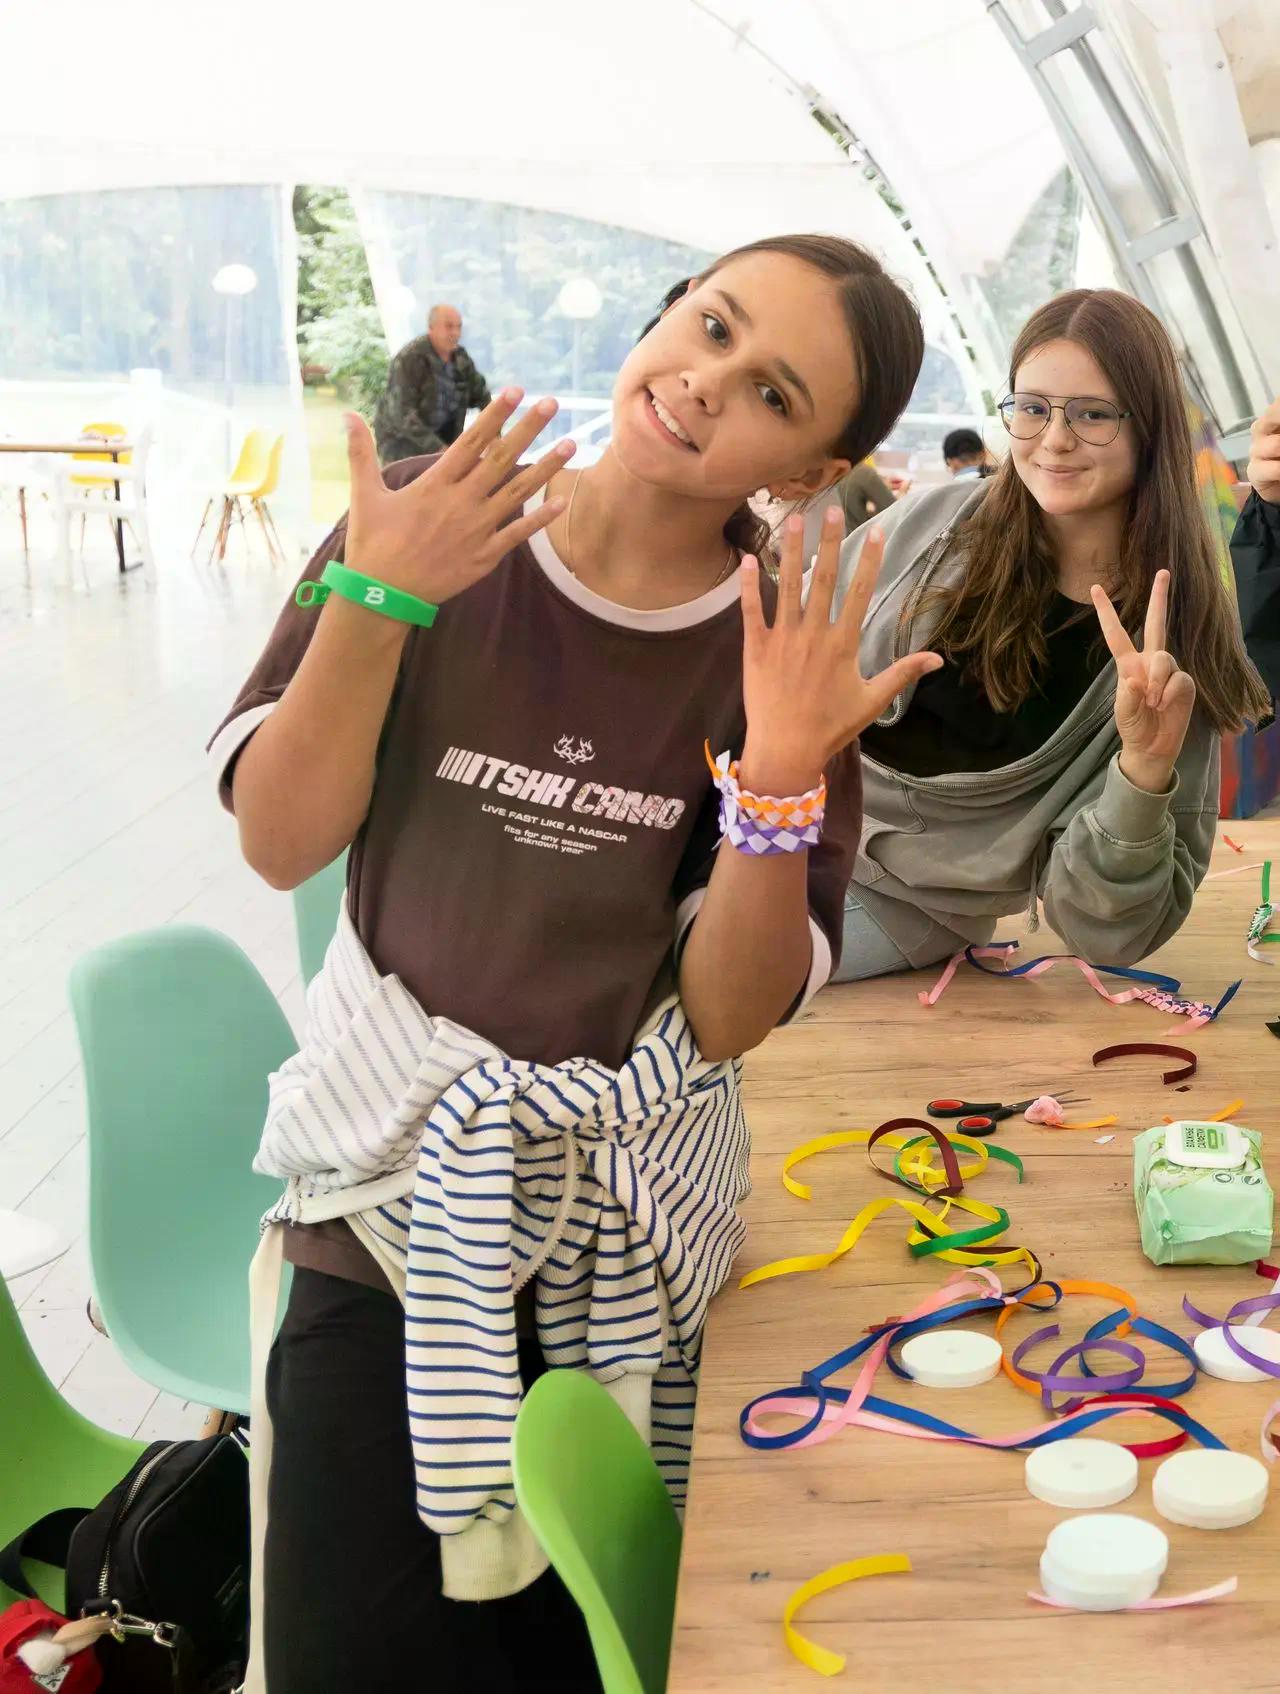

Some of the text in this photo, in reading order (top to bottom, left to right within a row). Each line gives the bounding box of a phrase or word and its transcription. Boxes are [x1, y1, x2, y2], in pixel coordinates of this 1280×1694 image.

[572, 782, 686, 830] CAMO
[481, 803, 628, 843] LIVE FAST LIKE A NASCAR
[504, 824, 598, 851] fits for any season
[514, 836, 584, 855] unknown year
